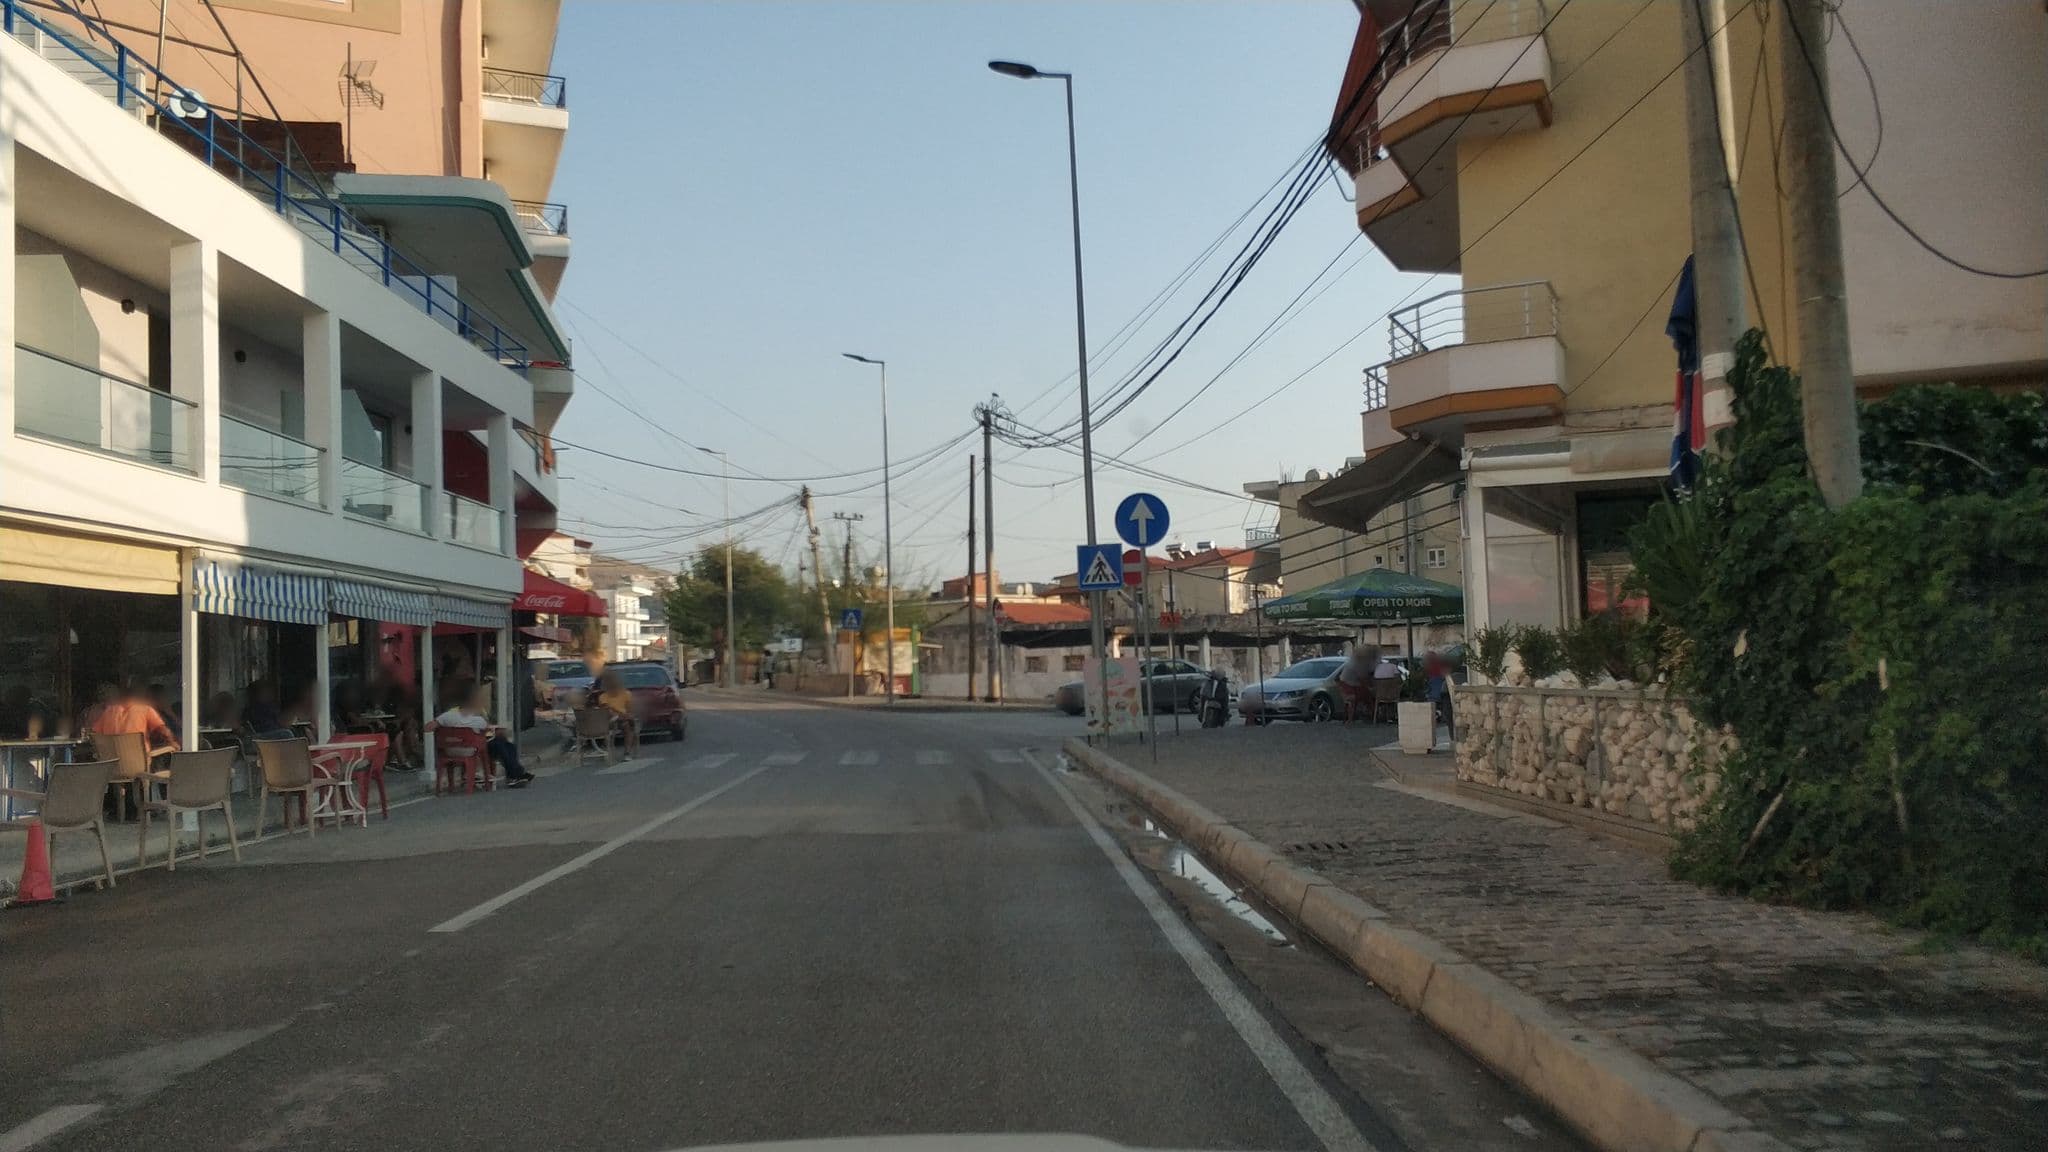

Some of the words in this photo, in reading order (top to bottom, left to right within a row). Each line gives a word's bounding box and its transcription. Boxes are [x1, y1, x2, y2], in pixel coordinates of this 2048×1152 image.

[1363, 598, 1389, 607] OPEN
[1391, 598, 1404, 607] TO
[1406, 598, 1432, 607] MORE
